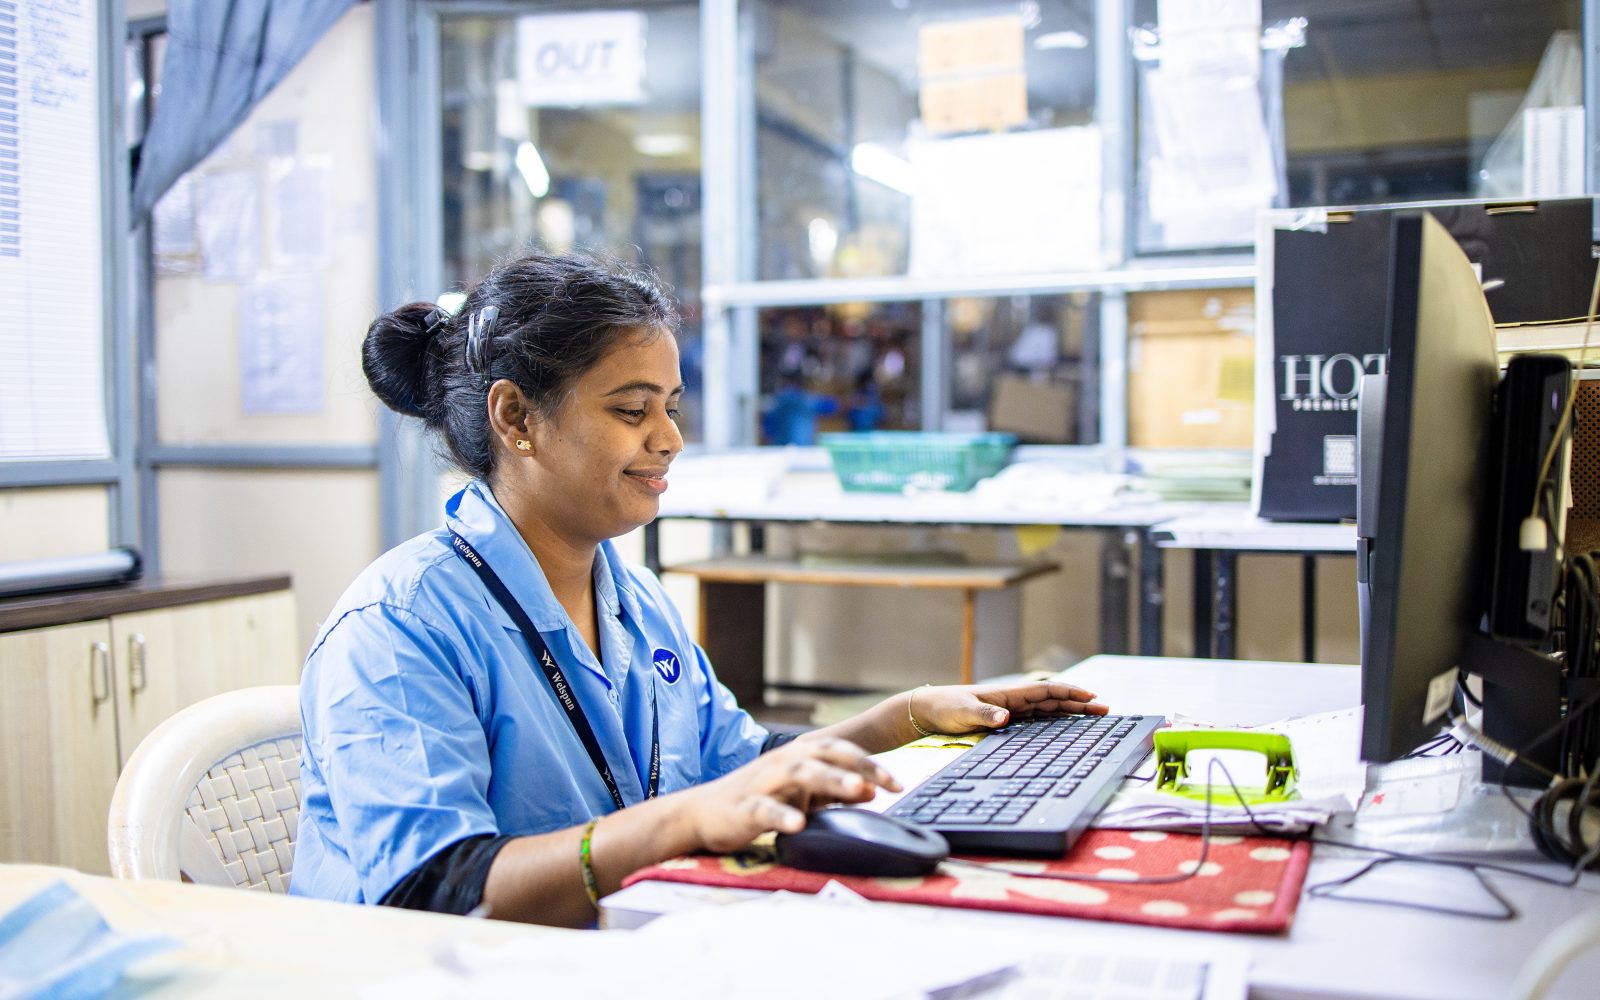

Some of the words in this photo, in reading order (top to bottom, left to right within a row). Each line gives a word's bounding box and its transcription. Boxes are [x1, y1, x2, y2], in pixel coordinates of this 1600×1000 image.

[535, 39, 617, 76] OUT
[453, 536, 482, 568] Welspun
[552, 671, 575, 711] Welspun
[650, 743, 659, 780] Welspun
